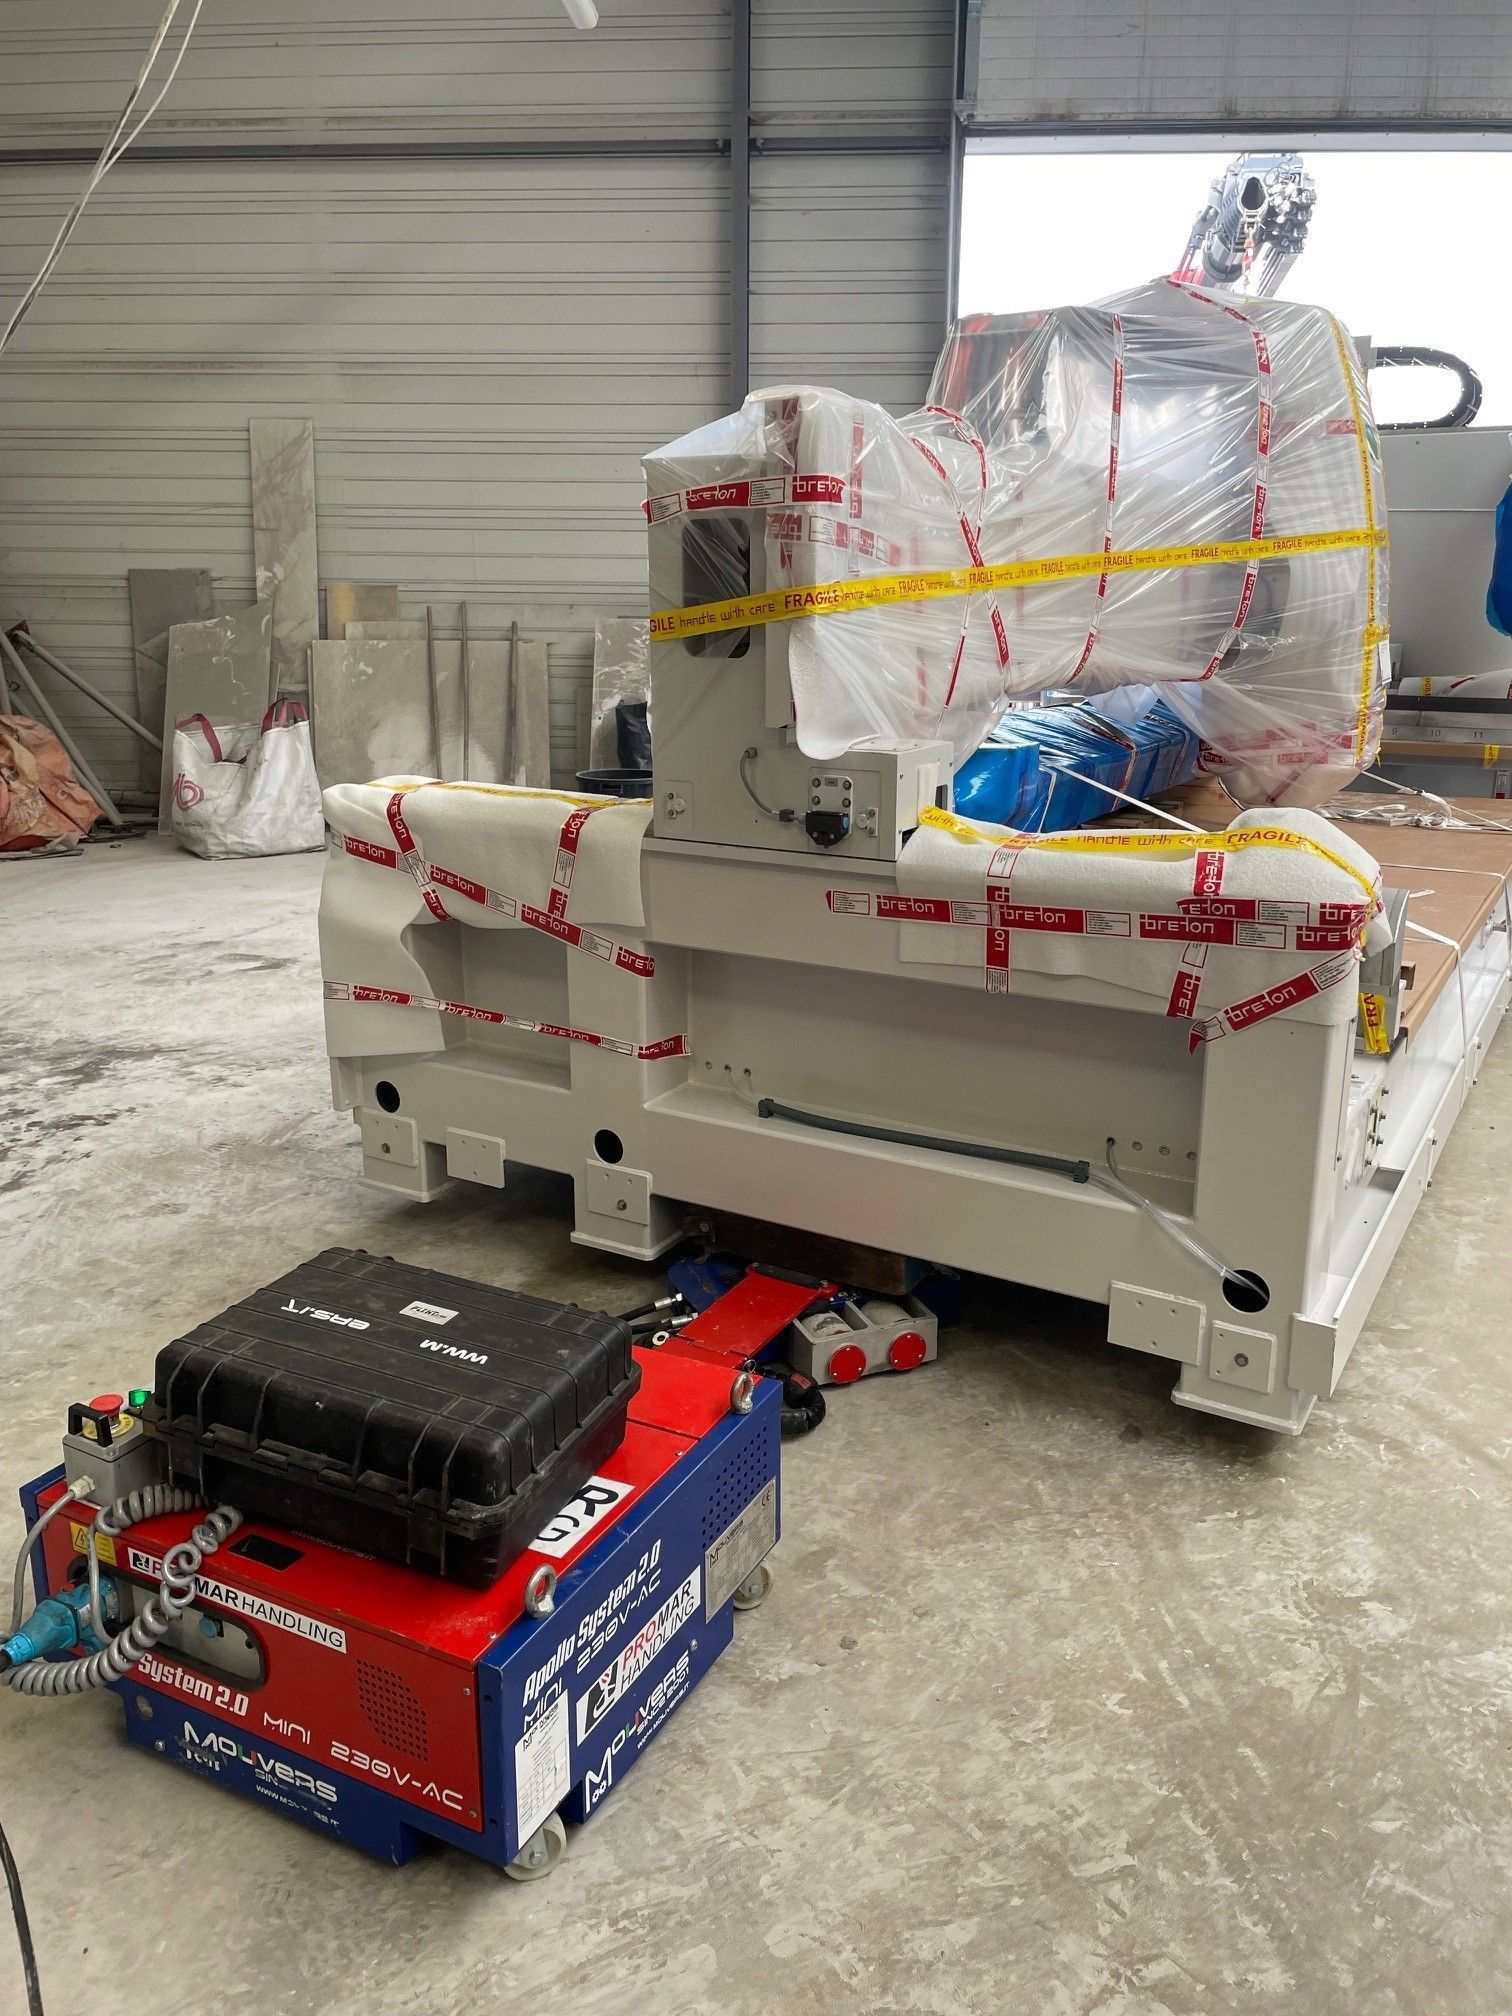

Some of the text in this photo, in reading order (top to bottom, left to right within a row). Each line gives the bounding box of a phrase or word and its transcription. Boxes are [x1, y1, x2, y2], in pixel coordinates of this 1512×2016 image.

[679, 613, 716, 629] handle
[721, 605, 745, 622] with
[750, 603, 775, 616] care
[785, 591, 840, 610] FRAGILE
[898, 579, 925, 595] FRAGILE
[969, 571, 993, 585] FRAGILE
[1041, 561, 1064, 574] FRAGILE
[1104, 555, 1133, 568] FRAGILE
[1159, 552, 1172, 563] with
[1191, 548, 1218, 559] FRAGILE
[1273, 538, 1302, 551] FRAGILE
[1239, 574, 1256, 619] breton
[344, 836, 386, 859] breton
[1138, 834, 1172, 846] with
[431, 865, 475, 894] breton
[522, 904, 569, 934] breton
[876, 895, 934, 913] breton
[999, 905, 1066, 923] breton
[1179, 898, 1236, 915] reton
[1139, 914, 1214, 934] breton
[353, 986, 399, 1003] breton
[446, 1002, 492, 1020] breton
[1224, 986, 1297, 1022] breton
[242, 1595, 343, 1648] HANDLING
[523, 1634, 576, 1707] Apollo
[577, 1569, 637, 1648] System
[637, 1539, 661, 1584] 2.0
[622, 1579, 691, 1671] PROMAR
[523, 1677, 562, 1733] MINI
[576, 1568, 661, 1675] 230V-AC
[620, 1596, 694, 1693] HANDLING
[138, 1653, 249, 1717] System 2.0
[637, 1666, 690, 1735] SINCE 2001
[263, 1711, 464, 1811] MINI 230V-AC
